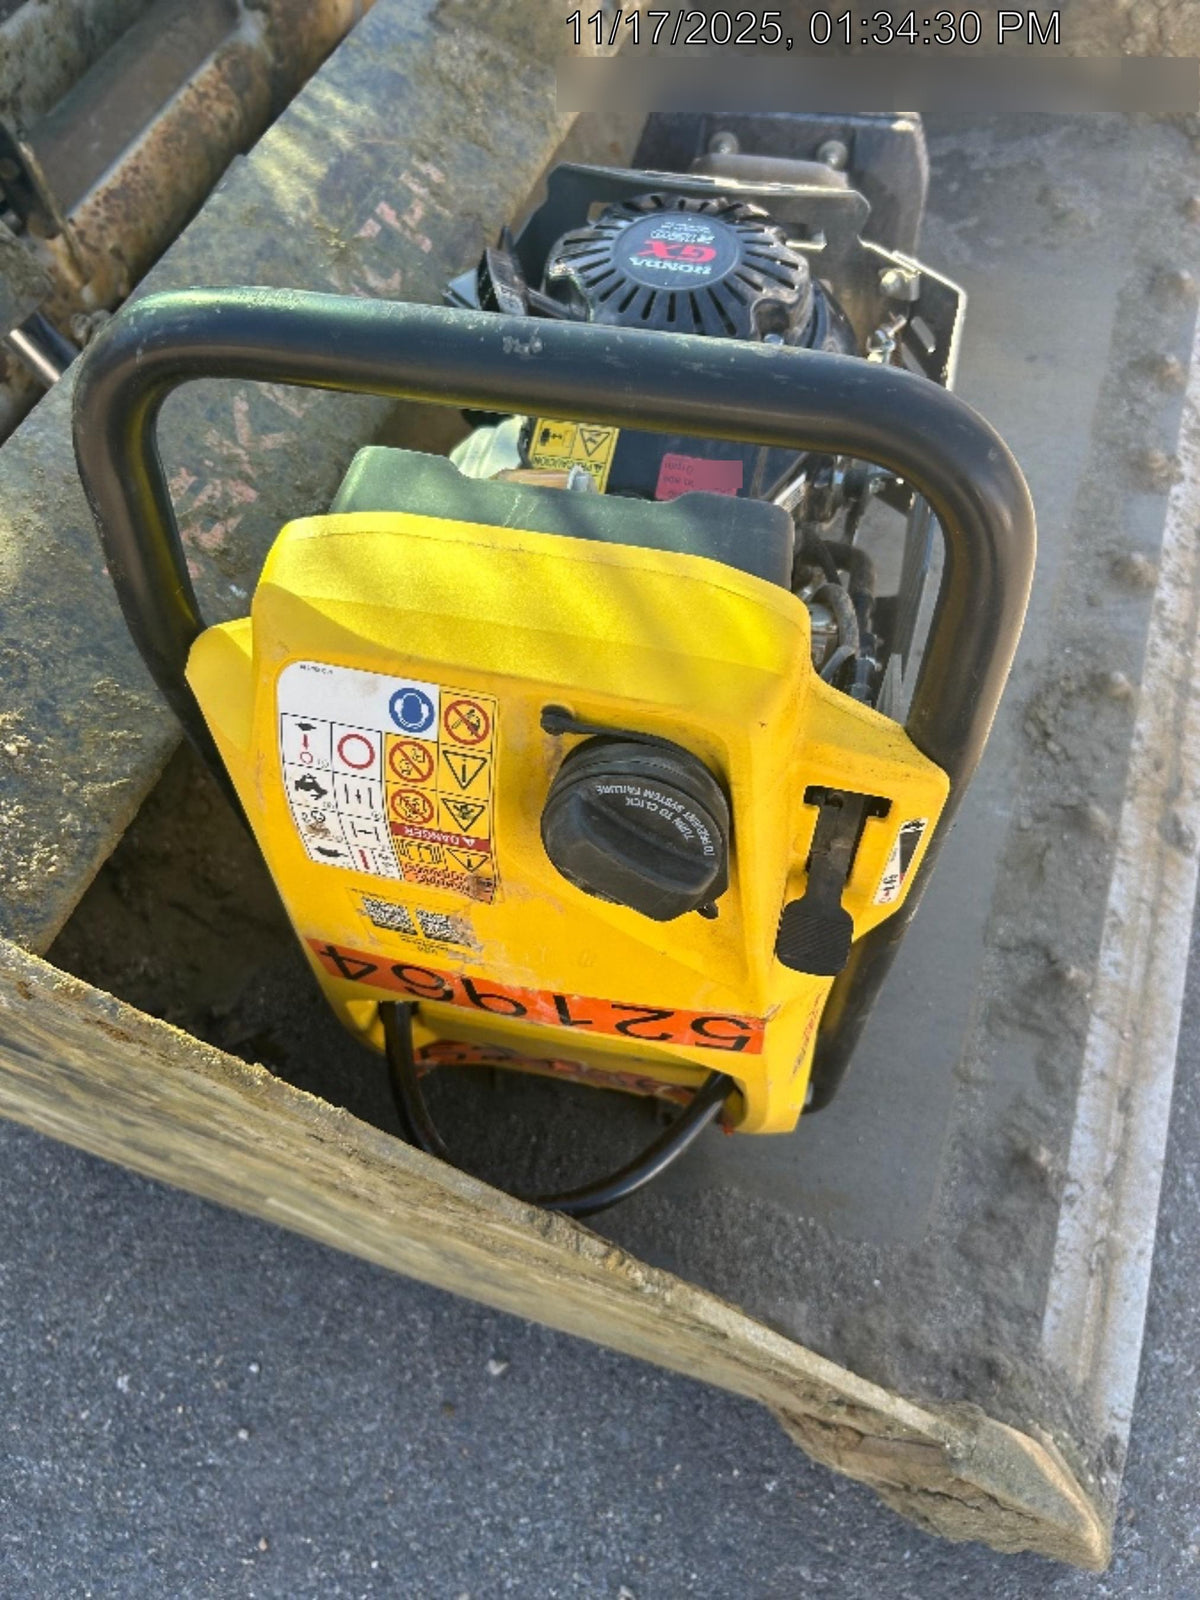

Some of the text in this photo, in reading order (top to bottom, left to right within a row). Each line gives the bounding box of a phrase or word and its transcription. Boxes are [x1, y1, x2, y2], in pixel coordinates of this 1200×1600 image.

[637, 239, 717, 264] GX
[629, 257, 712, 275] HONDA
[596, 785, 716, 856] TO PREVENT SYSTEM FAILURE
[659, 808, 674, 820] TO
[404, 827, 461, 846] DANGER
[672, 818, 694, 841] TURN
[319, 944, 752, 1053] 521964
